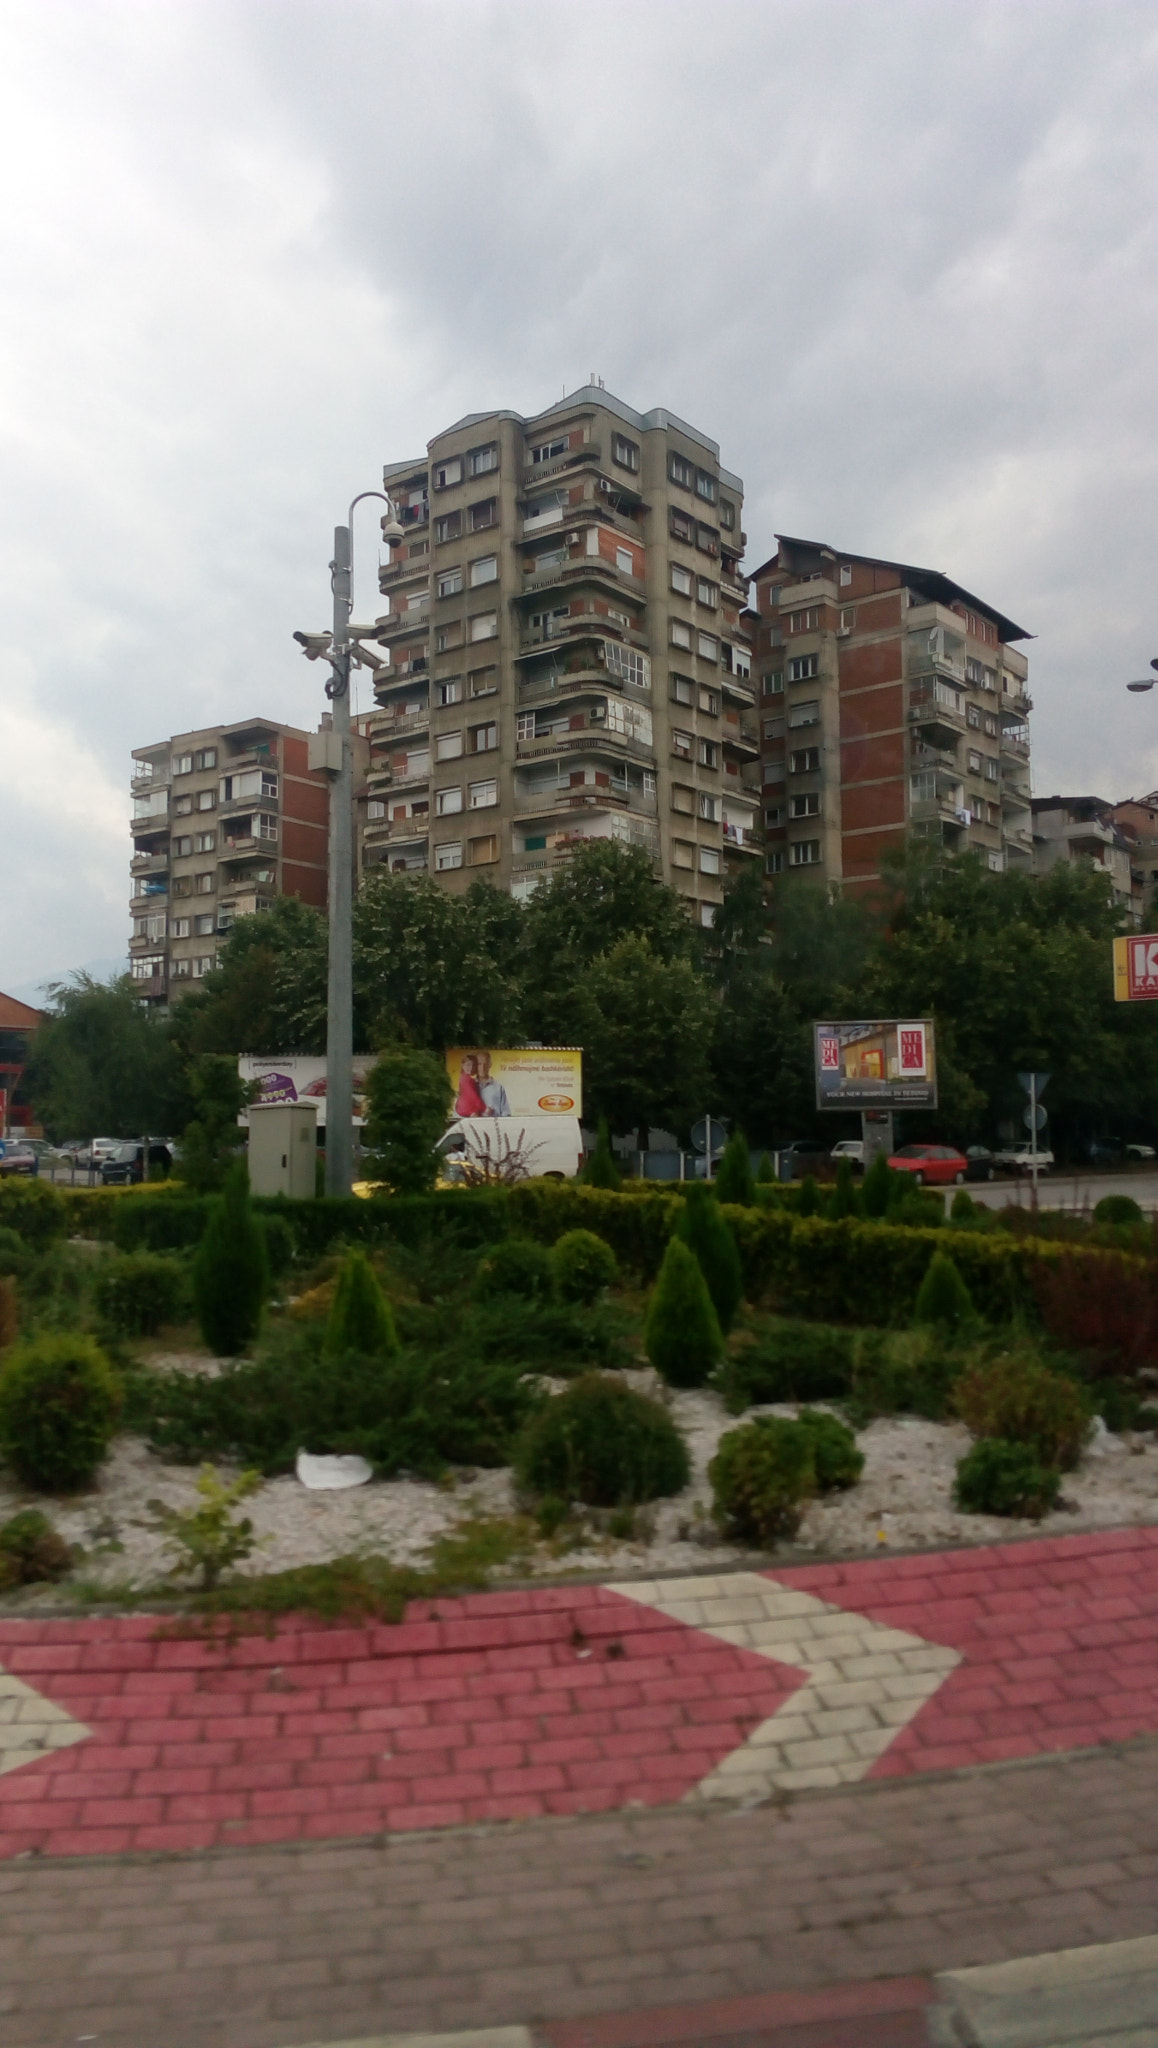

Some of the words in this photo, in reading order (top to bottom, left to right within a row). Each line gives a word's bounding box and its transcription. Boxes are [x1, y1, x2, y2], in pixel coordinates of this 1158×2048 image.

[1135, 976, 1158, 987] KA
[902, 1032, 922, 1043] ME
[902, 1044, 917, 1055] DI
[902, 1056, 921, 1067] CA
